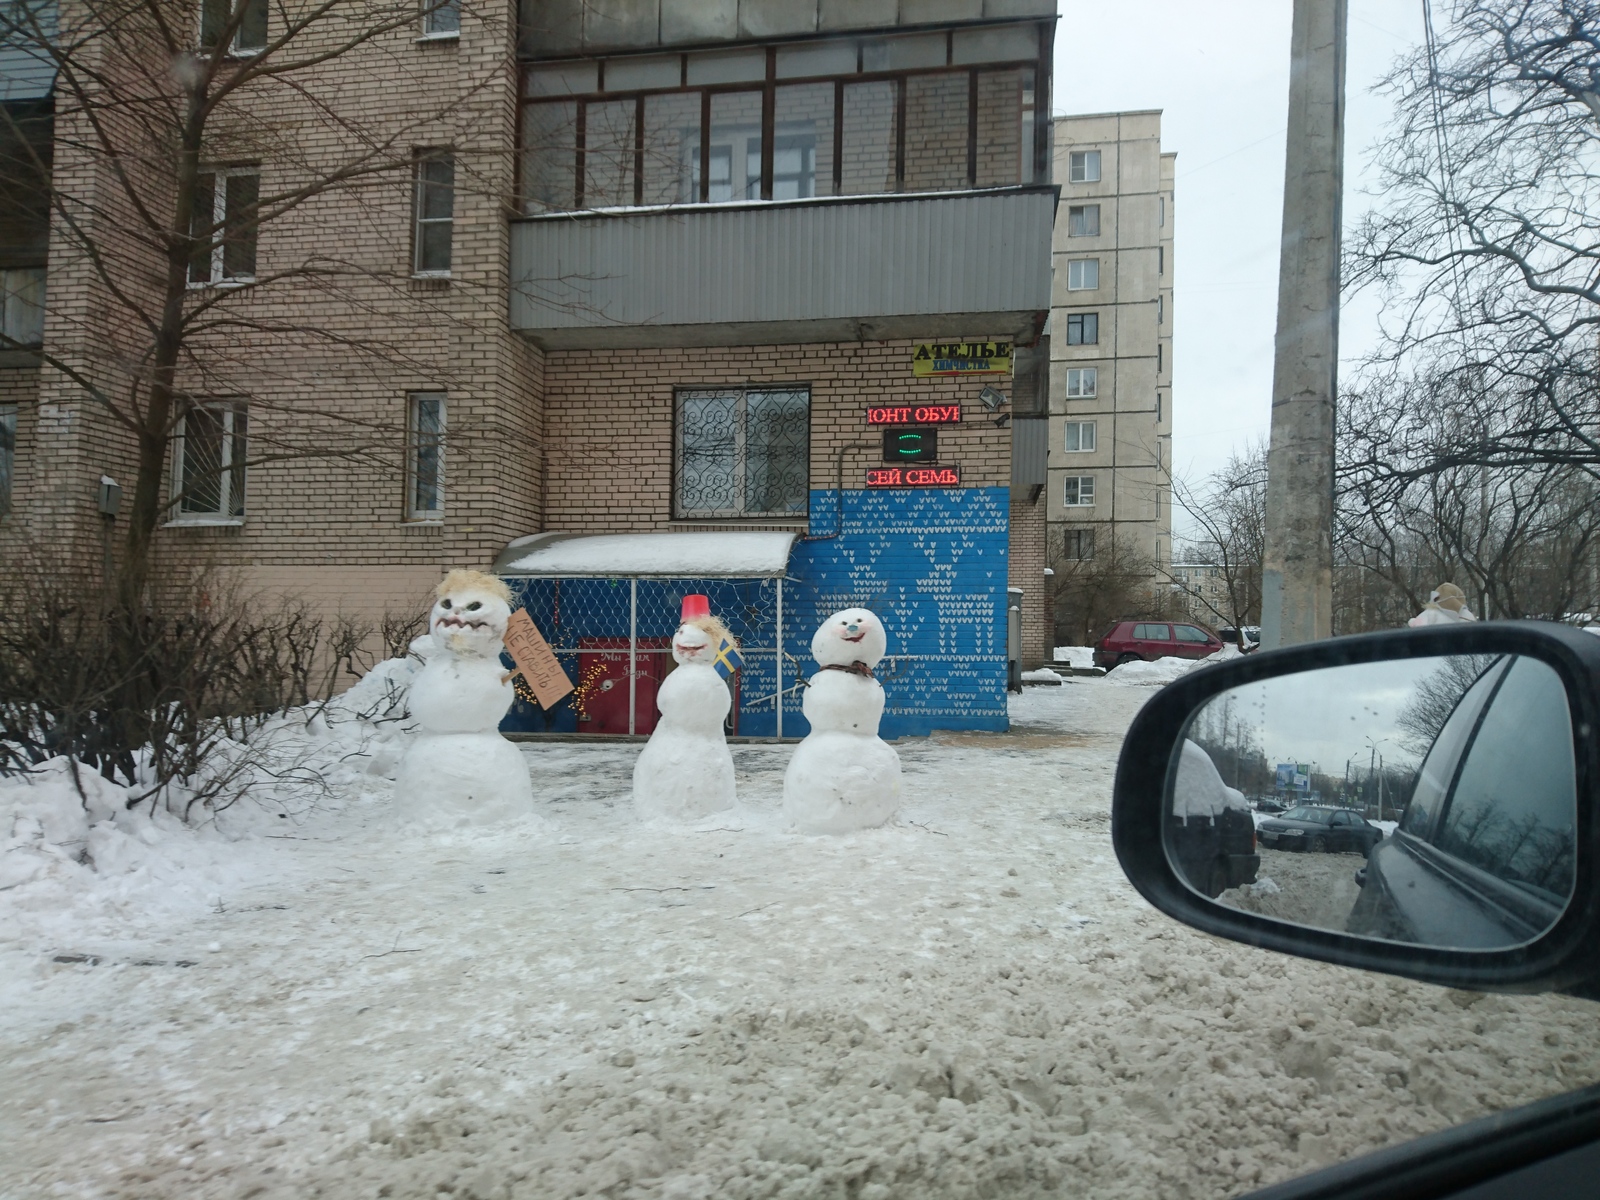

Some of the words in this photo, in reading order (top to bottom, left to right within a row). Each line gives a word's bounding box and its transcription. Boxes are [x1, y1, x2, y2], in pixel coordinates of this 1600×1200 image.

[914, 342, 1010, 360] АТЕЛЬЕ
[932, 358, 990, 371] ХИМЧИСТКА
[867, 468, 902, 485] СЕЙ
[506, 625, 525, 648] НЕ
[516, 618, 562, 677] МАШИНЫ
